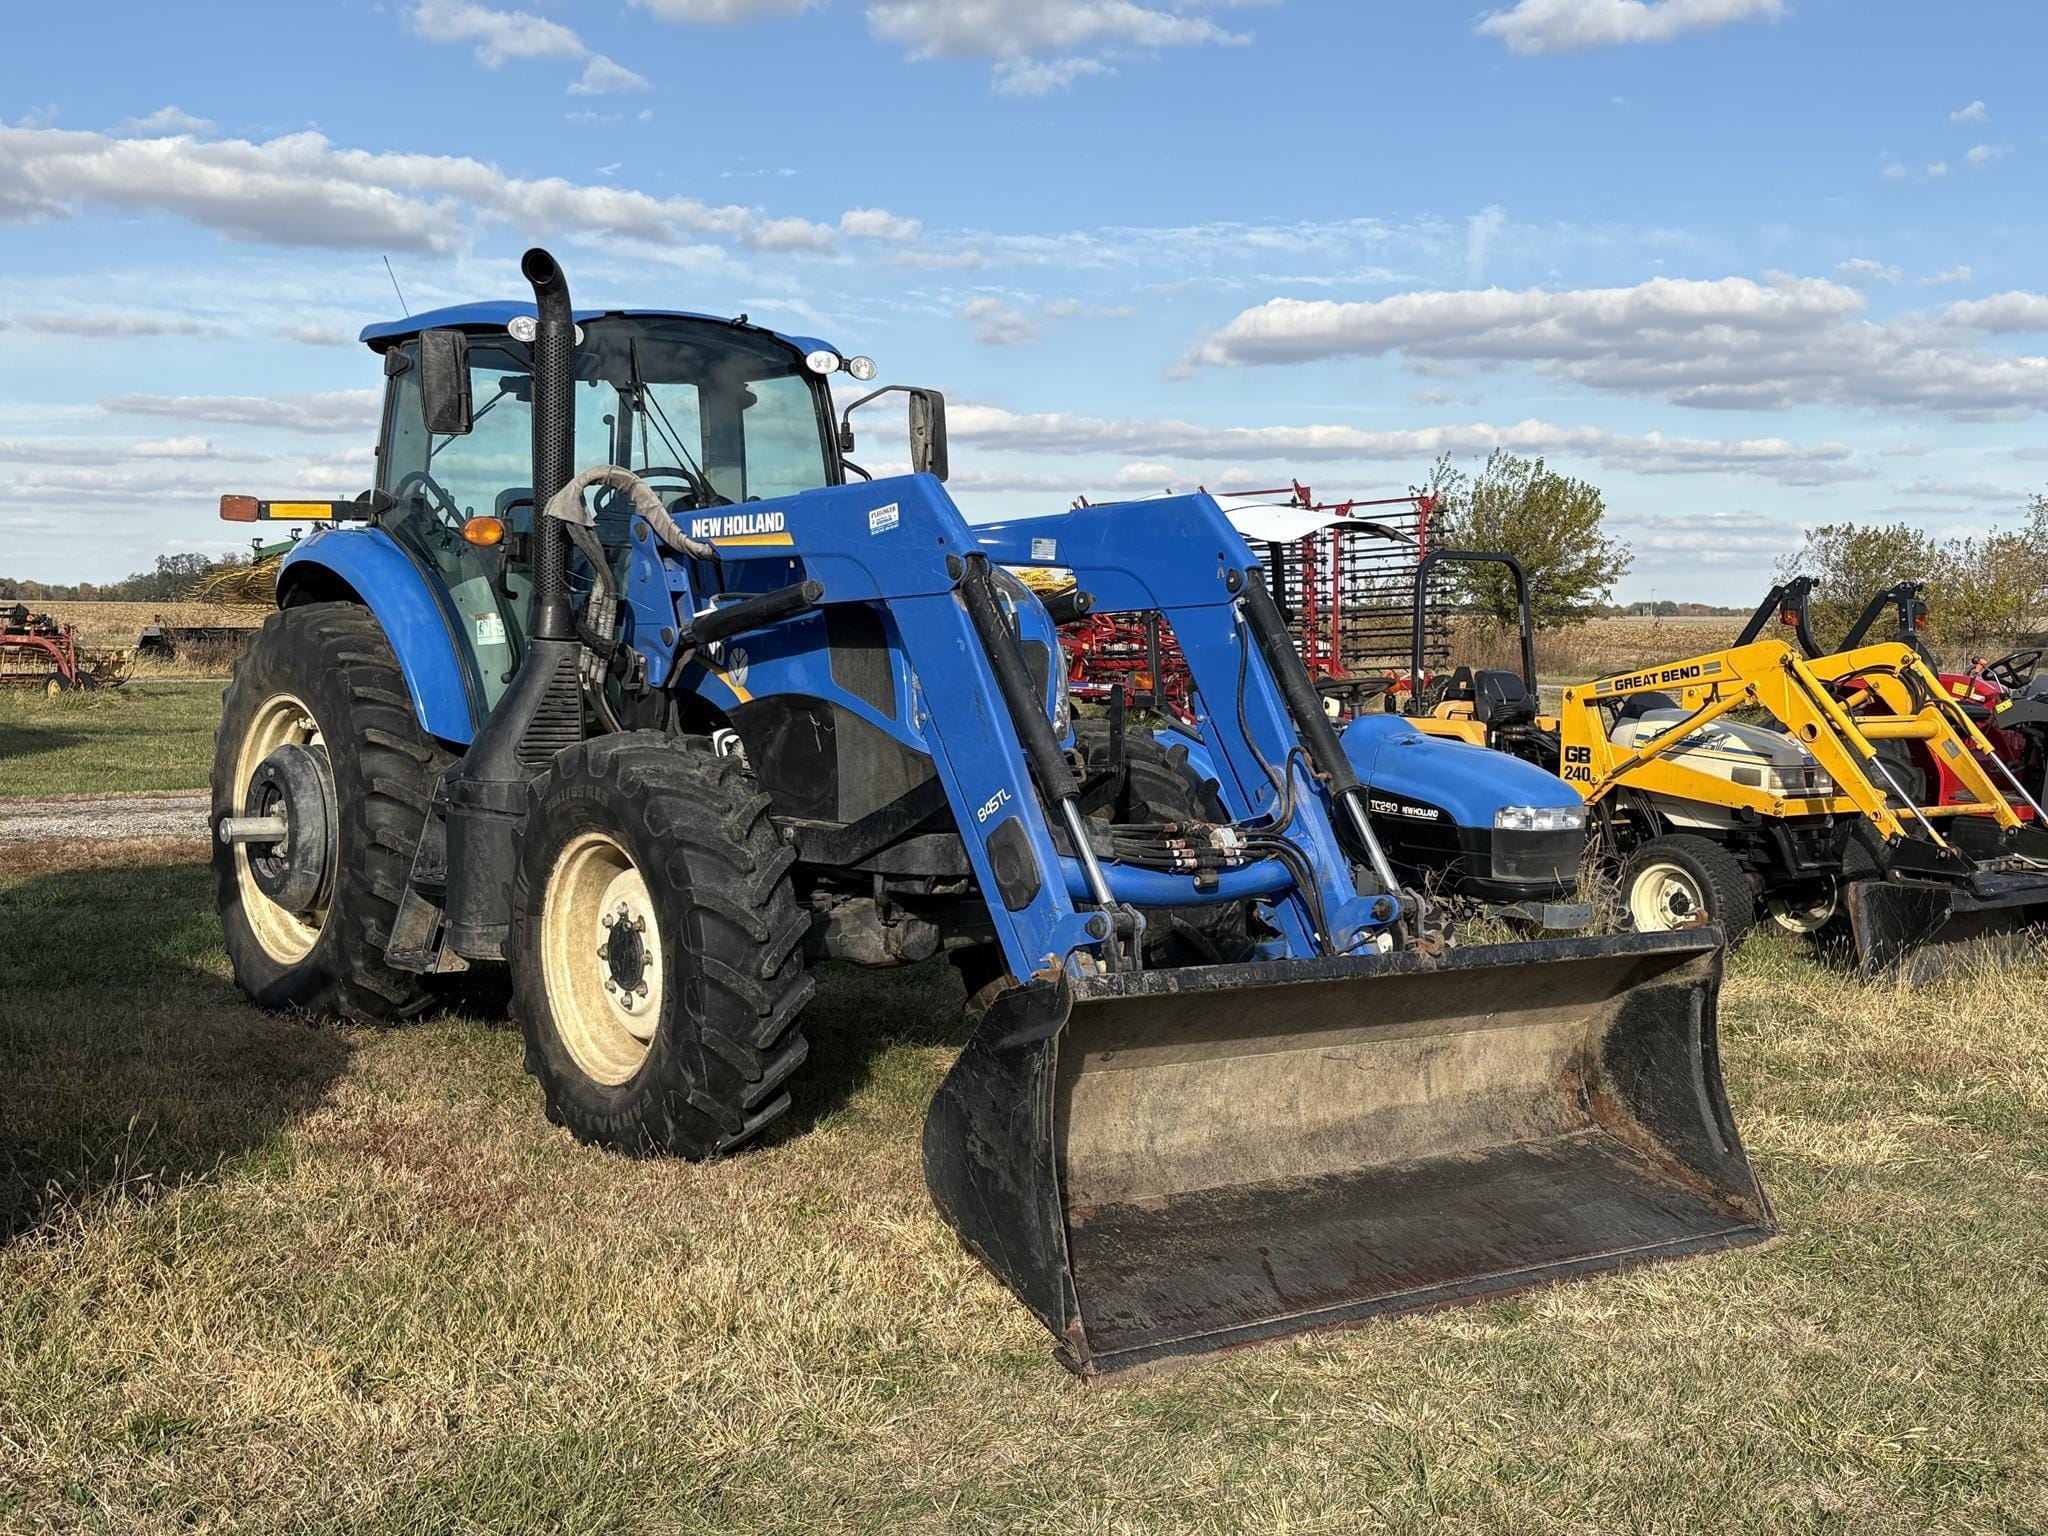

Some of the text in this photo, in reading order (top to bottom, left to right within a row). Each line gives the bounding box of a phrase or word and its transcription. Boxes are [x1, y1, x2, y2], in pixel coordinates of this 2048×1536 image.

[692, 512, 785, 538] NEW HOLLAND
[1615, 665, 1700, 691] GREAT BEND
[1564, 745, 1592, 764] GB
[1564, 765, 1591, 782] 240
[977, 788, 1012, 823] 845TL
